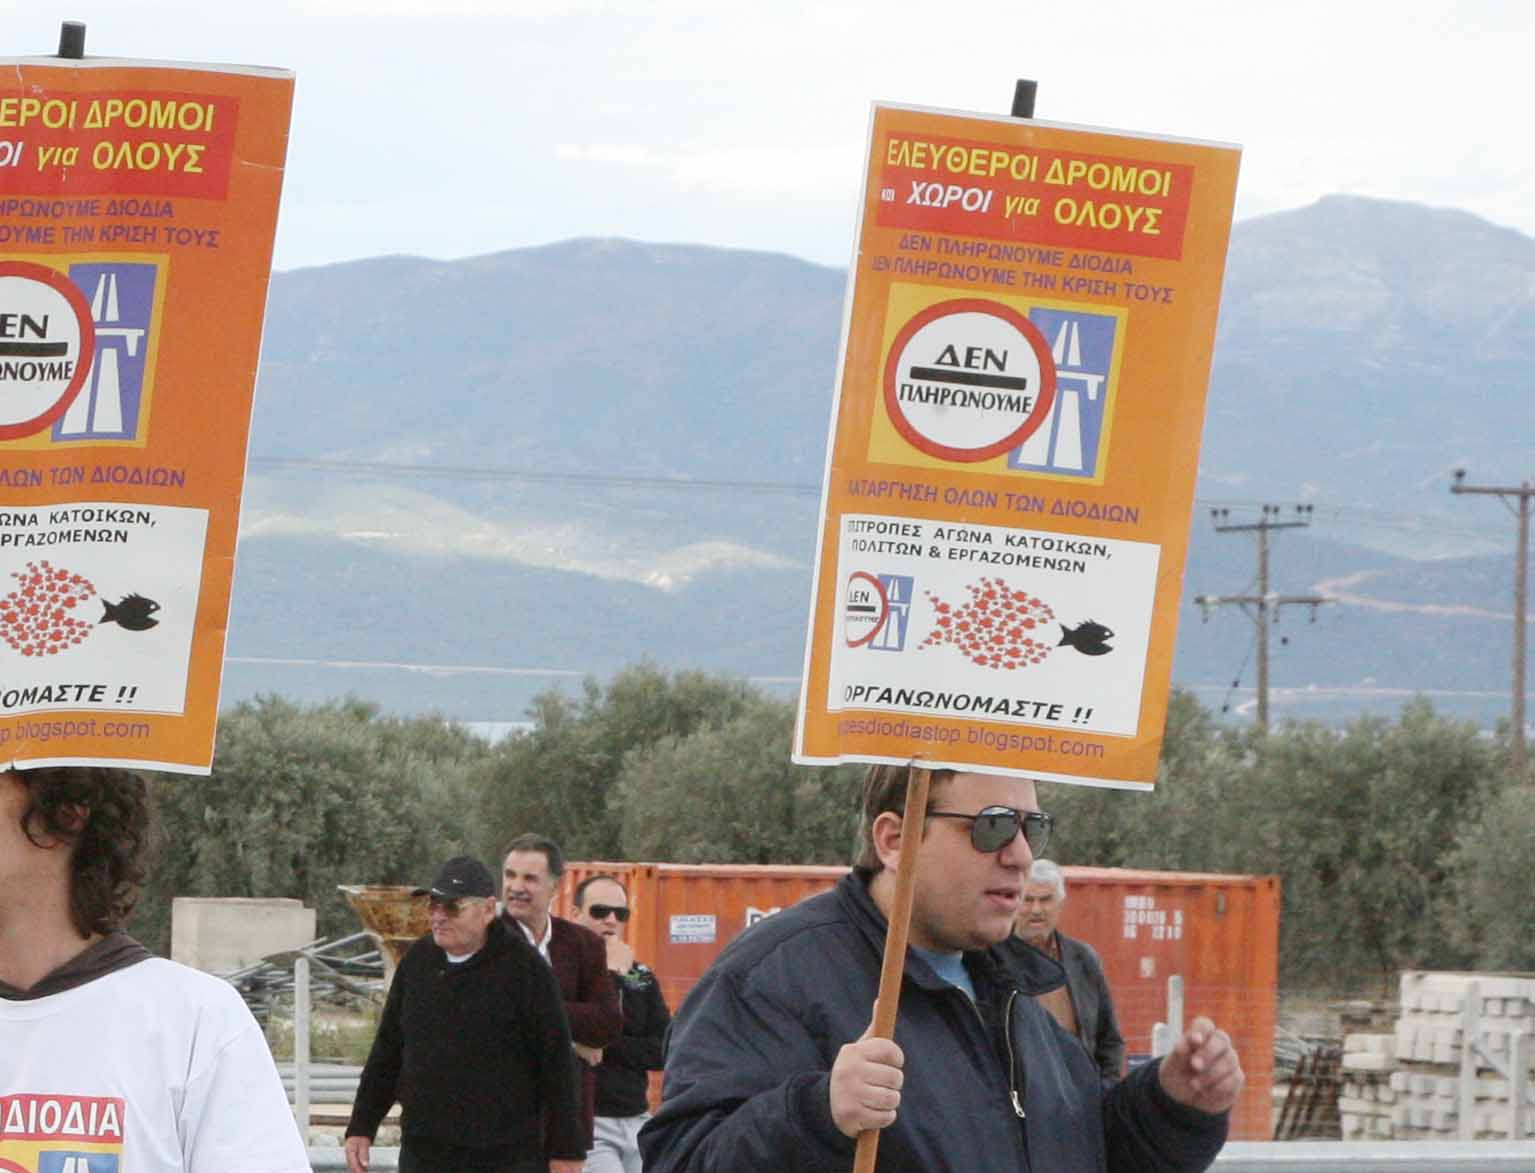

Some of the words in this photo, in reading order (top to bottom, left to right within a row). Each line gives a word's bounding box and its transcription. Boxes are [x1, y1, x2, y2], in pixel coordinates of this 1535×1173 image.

[82, 98, 215, 132] ΔΡΟΜΟΙ
[37, 145, 79, 172] για
[91, 142, 206, 174] ΟΛΟΥΣ
[887, 139, 1038, 182] ΕΛΕΥΘΕΡΟΙ
[1044, 158, 1172, 197] ΔΡΟΜΟΙ
[105, 199, 175, 219] ΔΙΟΔΙΑ
[906, 180, 993, 213] ΧΩΡΟΙ
[1003, 194, 1041, 219] για
[1054, 197, 1163, 236] ΟΛΟΥΣ
[62, 225, 96, 244] ΤΗΝ
[100, 225, 159, 246] ΚΡΙΣΗ
[163, 227, 221, 249] ΤΟΥΣ
[899, 234, 932, 250] ΔΕΝ
[937, 238, 1064, 267] ΠΛΗΡΩΝΟΥΜΕ
[1068, 252, 1133, 275] ΔΙΟΔΙΑ
[1022, 271, 1057, 289] ΤΗΝ
[1061, 276, 1119, 298] ΚΡΙΣΗ
[1123, 283, 1176, 304] ΤΟΥΣ
[934, 344, 1008, 372] ΔΕΝ
[899, 383, 1033, 414] ΠΛΗΡΩΝΟΥΜΕ
[49, 464, 85, 486] ΤΩΝ
[90, 463, 187, 489] ΔΙΟΔΙΩΝ
[49, 507, 158, 527] ΚΑΤΟΙΚΩΝ,
[944, 487, 997, 509] ΟΛΩΝ
[1005, 492, 1045, 513] ΤΩΝ
[1050, 502, 1141, 525] ΔΙΟΔΙΩΝ
[933, 526, 993, 545] ΑΓΩΝΑ
[1005, 533, 1113, 560] ΚΑΤΟΙΚΩΝ,
[928, 545, 942, 559] &
[947, 547, 1086, 573] ΕΡΓΑΖΟΜΕΝΩΝ
[115, 686, 138, 704] !!
[1071, 706, 1093, 725] !!
